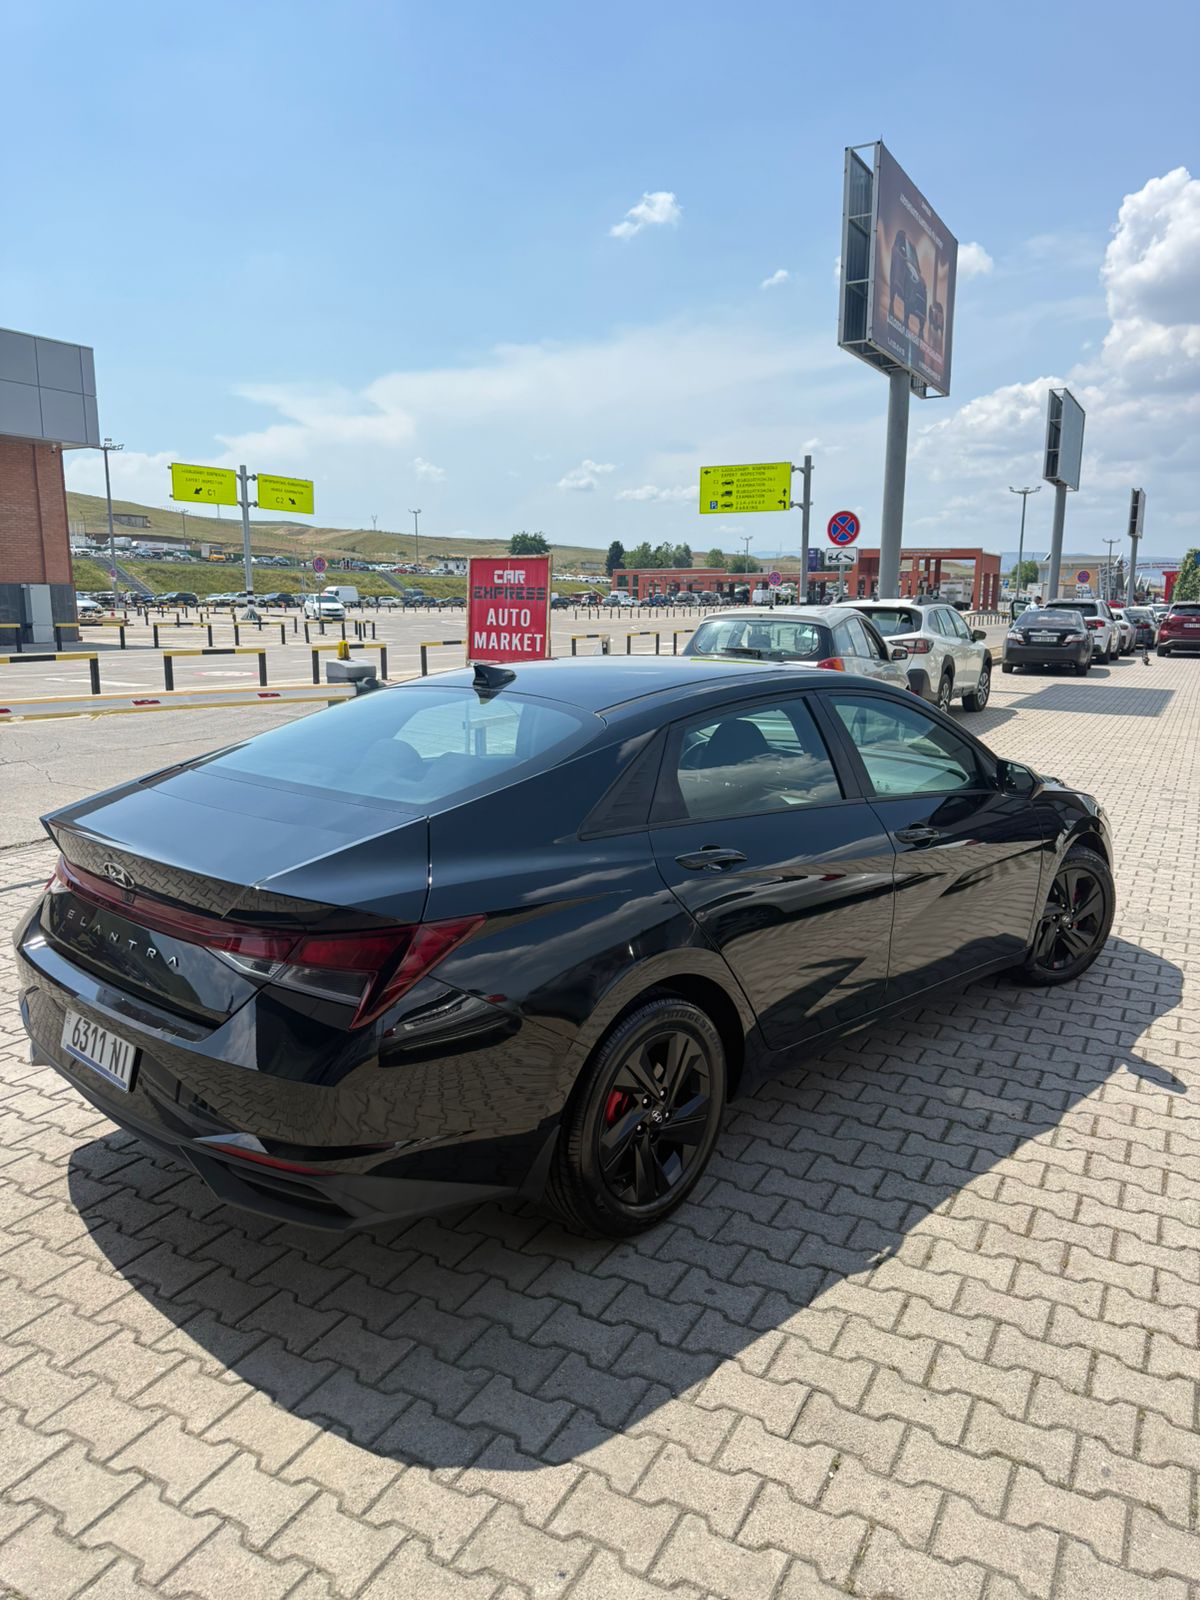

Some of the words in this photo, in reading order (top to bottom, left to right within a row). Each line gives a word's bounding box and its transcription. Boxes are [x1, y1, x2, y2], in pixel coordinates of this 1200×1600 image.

[207, 488, 216, 497] C1
[275, 496, 284, 504] C2
[494, 569, 526, 584] CAR
[473, 586, 545, 601] EXPRESS
[486, 608, 531, 627] AUTO
[474, 631, 544, 652] MARKET
[67, 909, 178, 967] ELANTRA
[72, 1017, 107, 1064] 6311
[109, 1037, 129, 1079] NI
